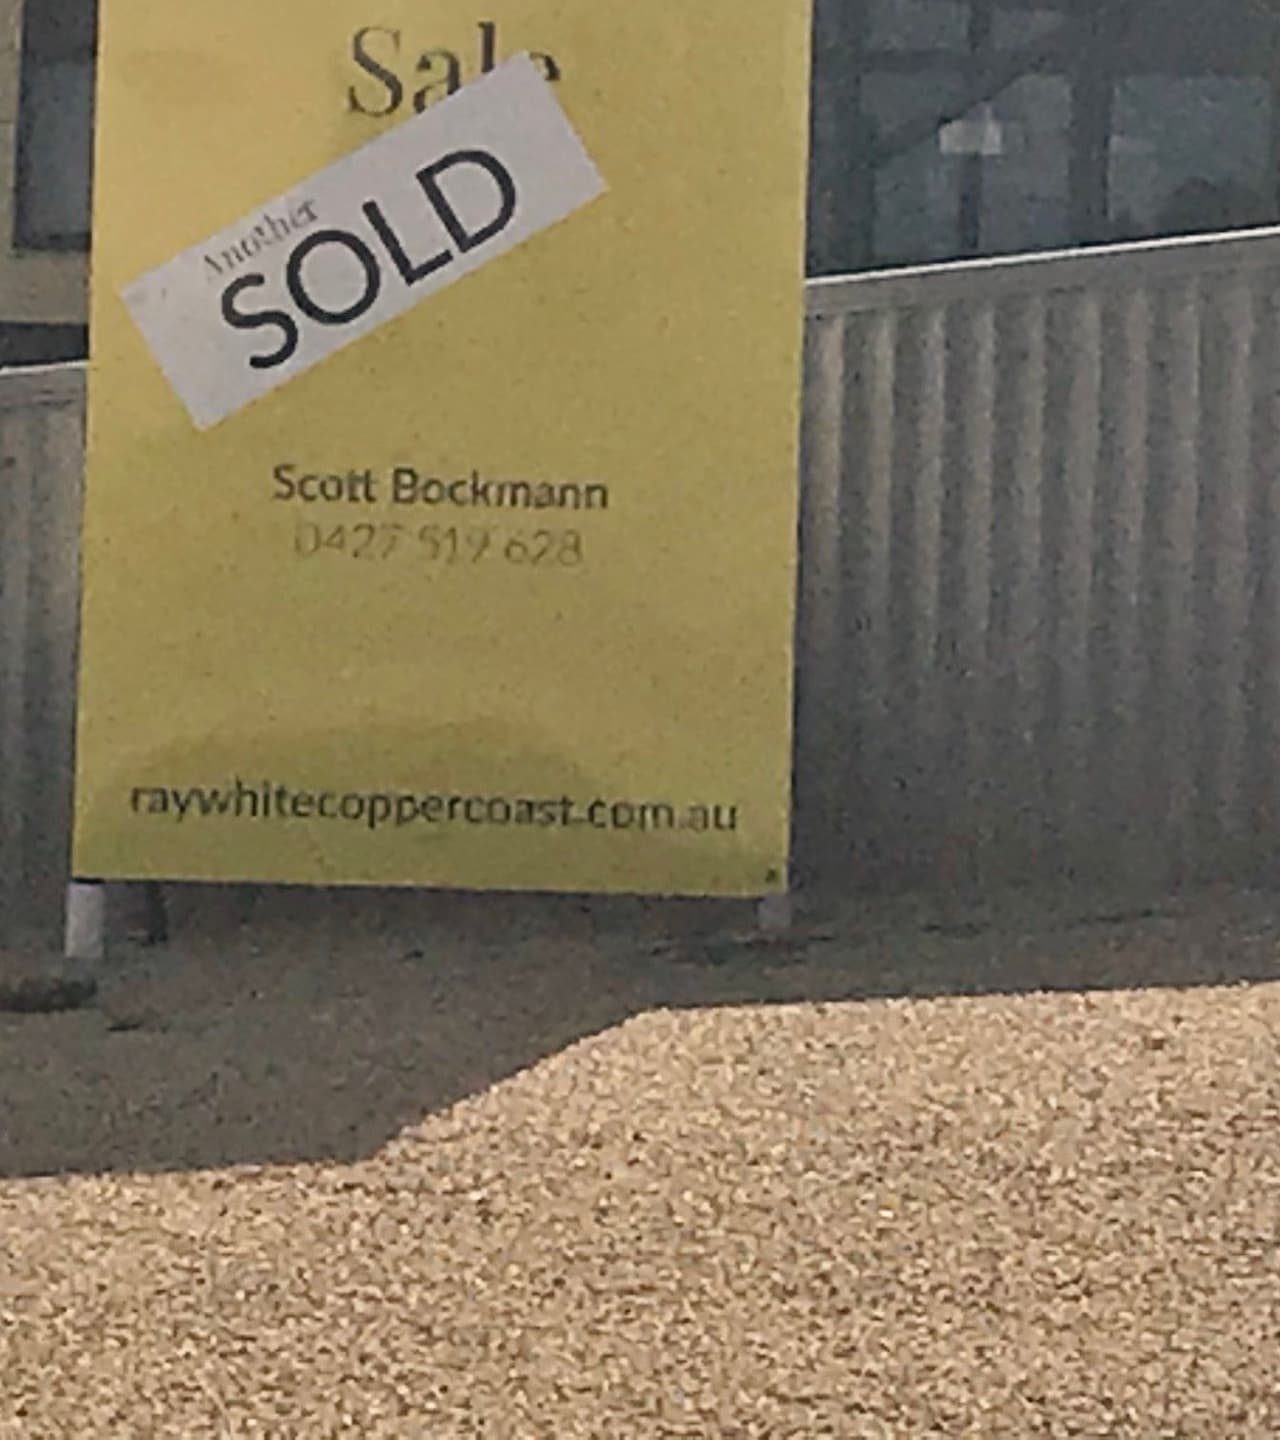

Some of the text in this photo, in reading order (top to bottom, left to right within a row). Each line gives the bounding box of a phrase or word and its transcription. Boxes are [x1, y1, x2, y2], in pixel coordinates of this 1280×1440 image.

[203, 199, 319, 284] Another
[220, 148, 517, 370] SOLD
[272, 463, 609, 510] Scott Bockmann
[293, 521, 406, 561] 0427
[503, 526, 584, 567] 628
[130, 774, 738, 831] raywhitecoppercoast.com.au
